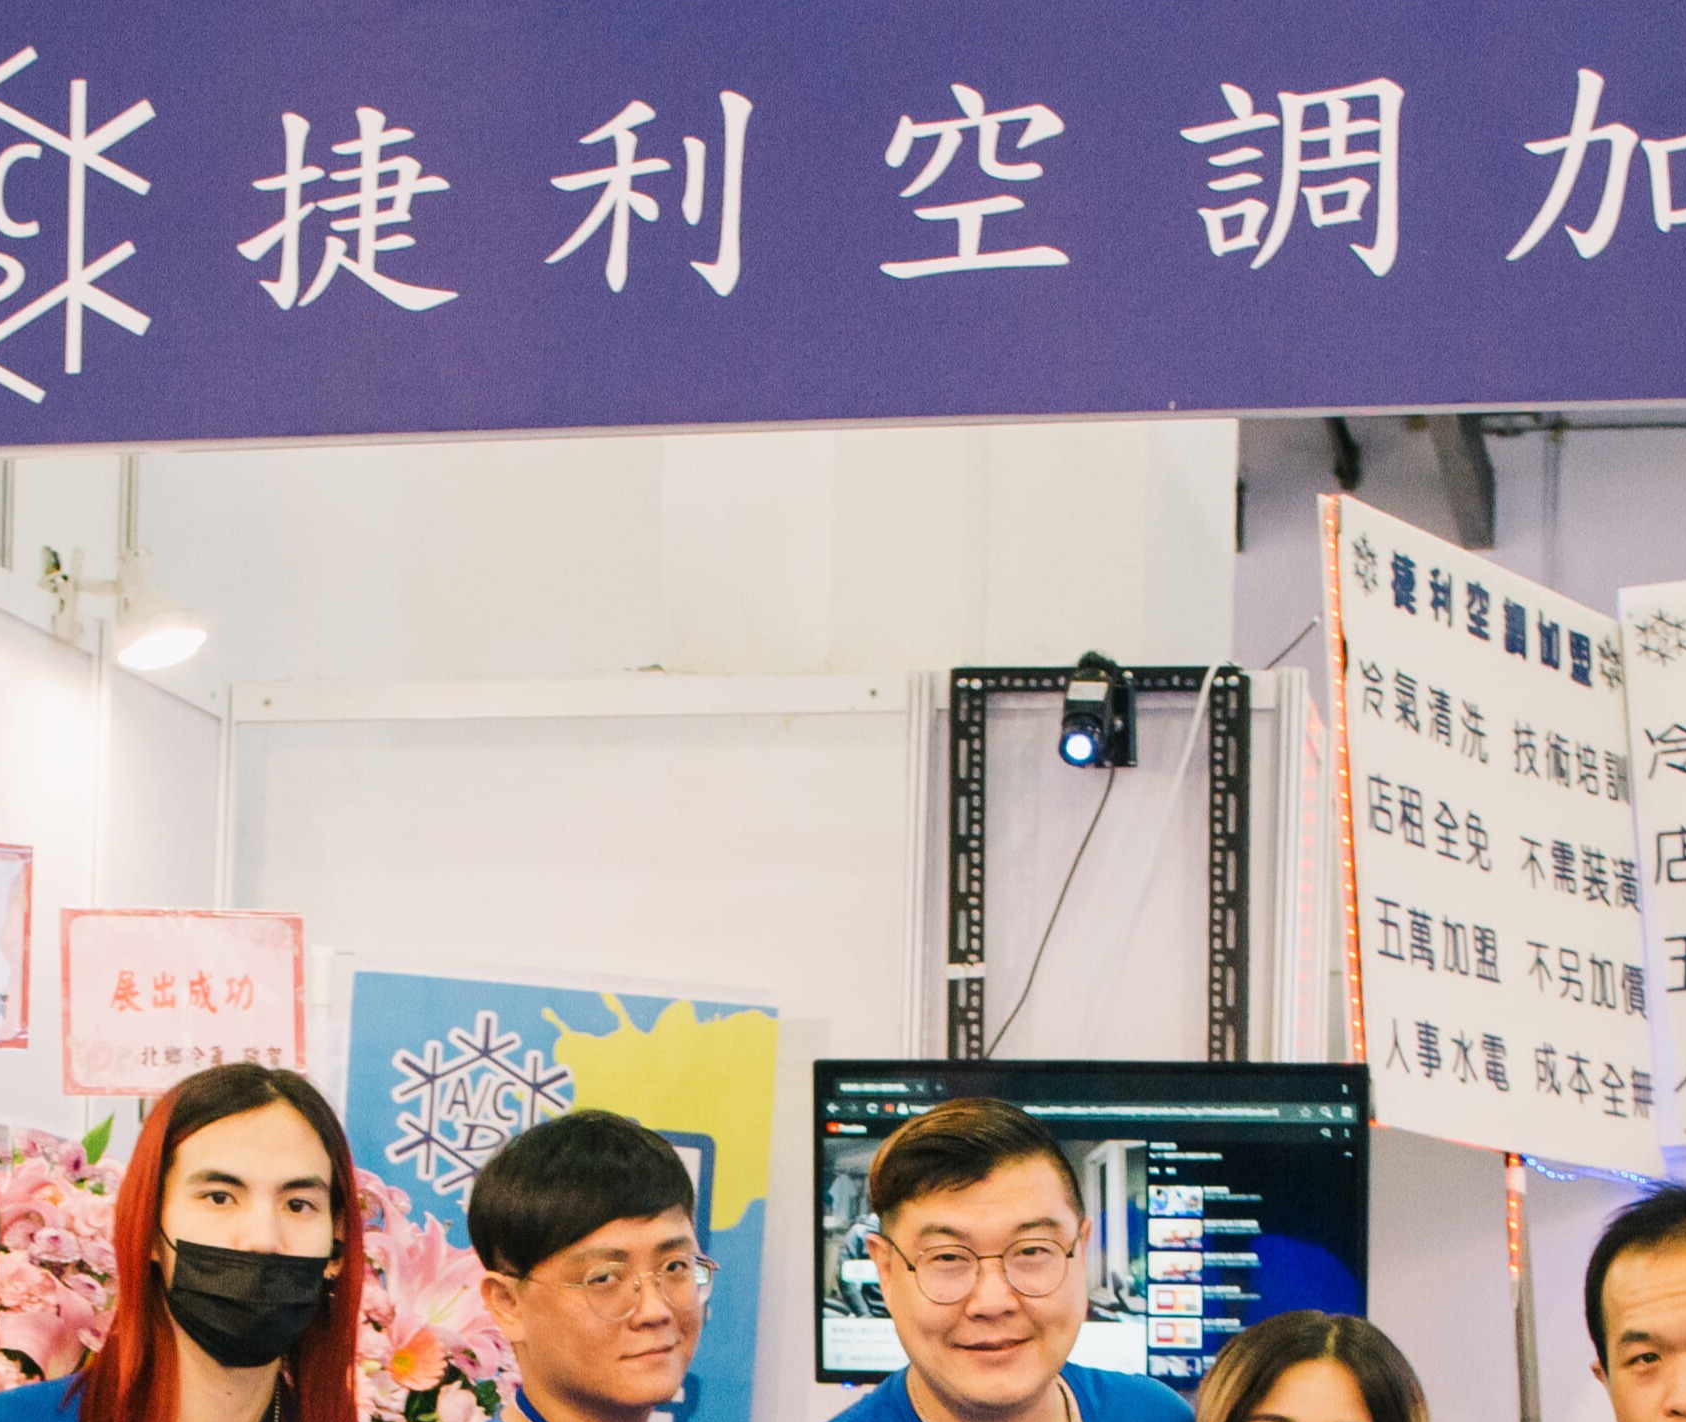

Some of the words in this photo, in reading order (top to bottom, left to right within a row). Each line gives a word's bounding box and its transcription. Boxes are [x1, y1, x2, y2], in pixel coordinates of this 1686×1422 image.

[1390, 549, 1593, 689] 捷利空調加盟
[1358, 658, 1489, 765] 冷氣清洗
[1513, 718, 1630, 806] 技術培訓
[1366, 772, 1493, 873] 店租全免
[1517, 833, 1642, 914] 不需裝潢
[109, 969, 257, 1014] 展出成功
[1374, 894, 1502, 985] 五萬加盟
[1525, 939, 1650, 1021] 不另加價
[446, 1074, 519, 1122] A/C
[1385, 1017, 1512, 1094] 人事水電
[1533, 1041, 1658, 1121] 成本全無
[457, 1122, 505, 1153] D
